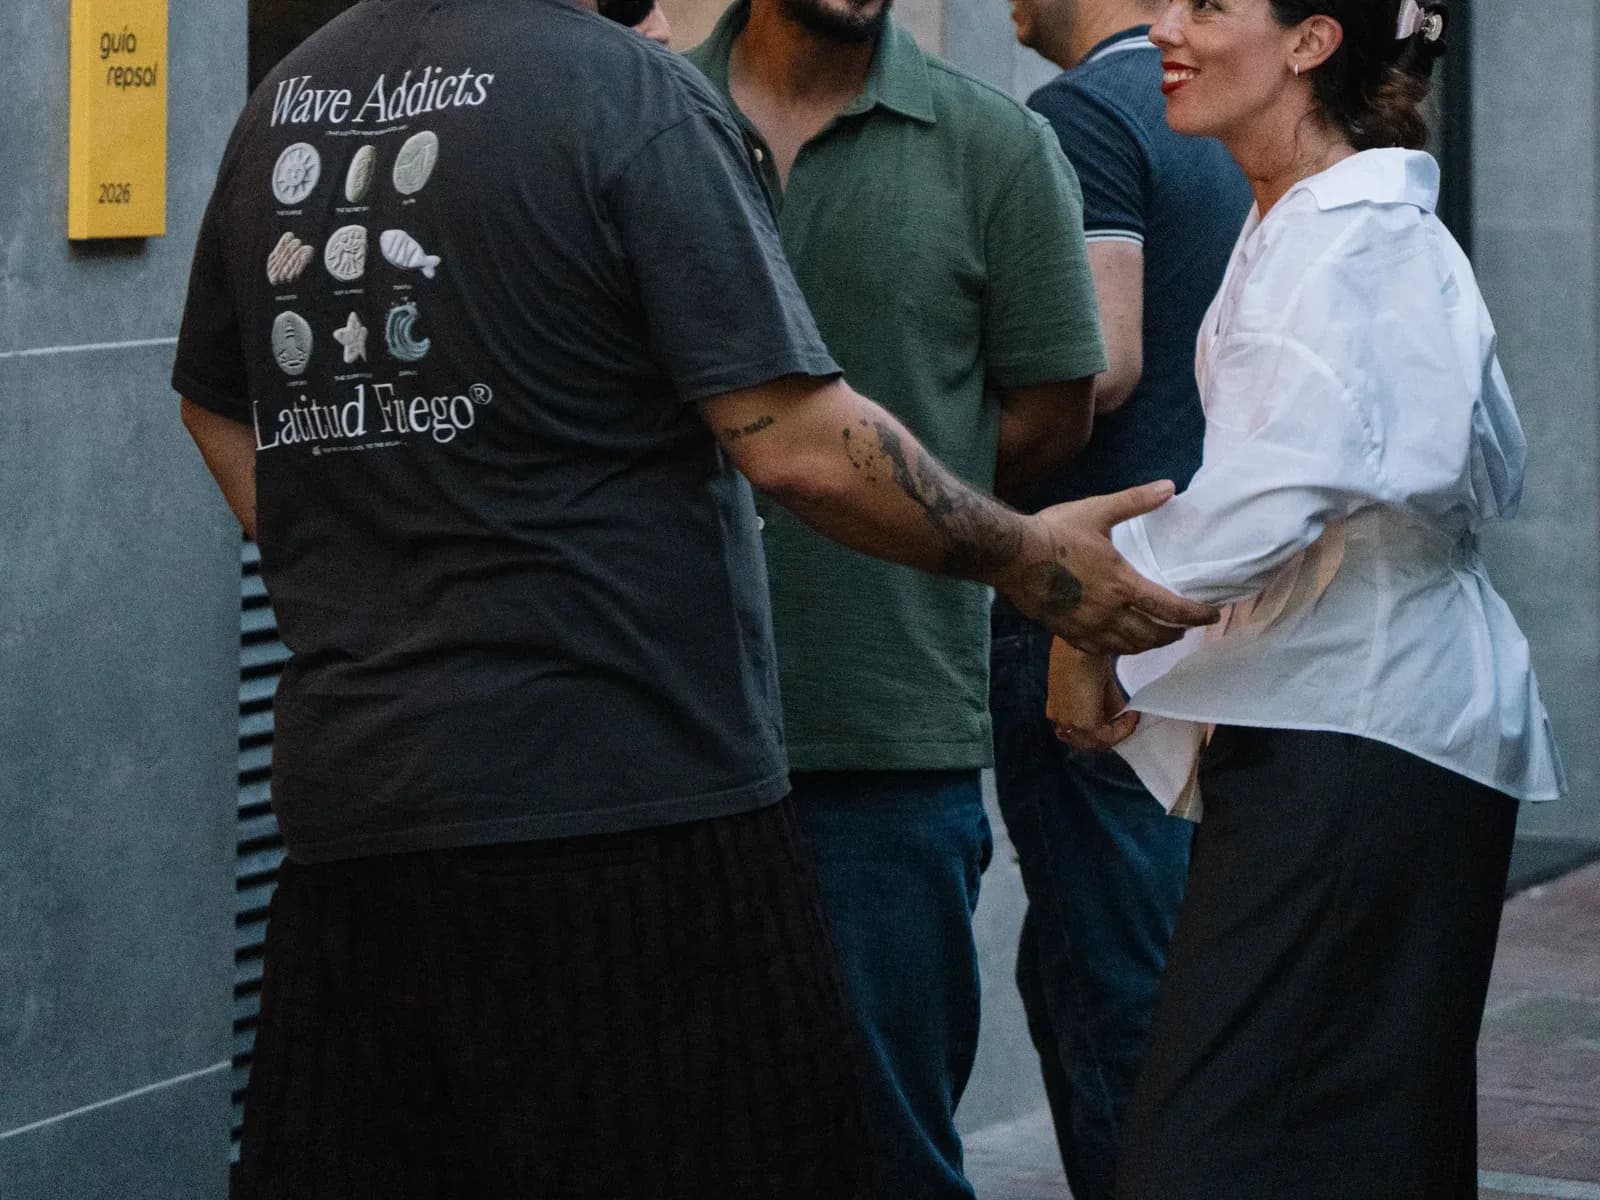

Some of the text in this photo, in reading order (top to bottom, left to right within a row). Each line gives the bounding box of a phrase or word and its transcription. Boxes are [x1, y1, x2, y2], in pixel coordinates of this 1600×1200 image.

[100, 25, 137, 59] guía
[107, 62, 158, 91] repsol
[270, 66, 494, 127] Wave Addicts
[98, 182, 131, 204] 2026
[252, 383, 367, 451] Latitud
